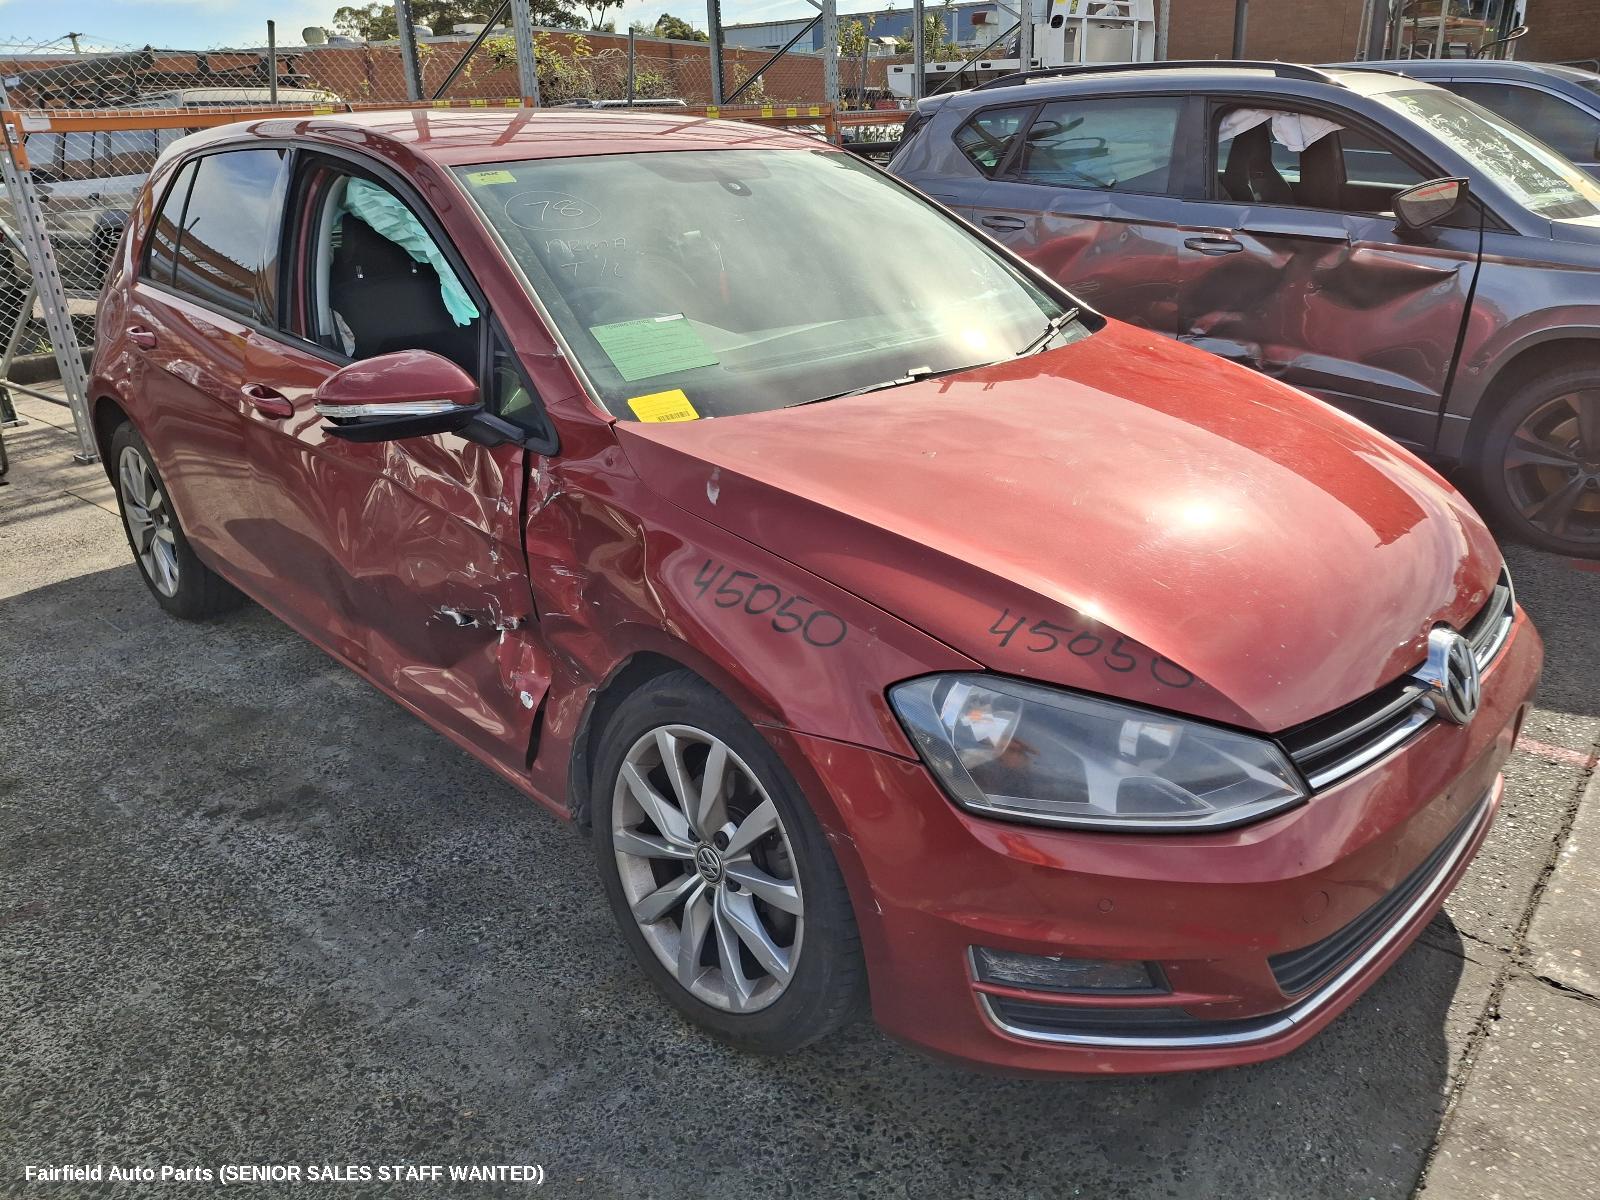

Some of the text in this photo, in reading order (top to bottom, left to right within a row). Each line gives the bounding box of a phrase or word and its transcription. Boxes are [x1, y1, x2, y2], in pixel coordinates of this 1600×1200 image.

[523, 200, 584, 221] 78
[694, 559, 848, 648] 45050
[987, 608, 1196, 688] 45050
